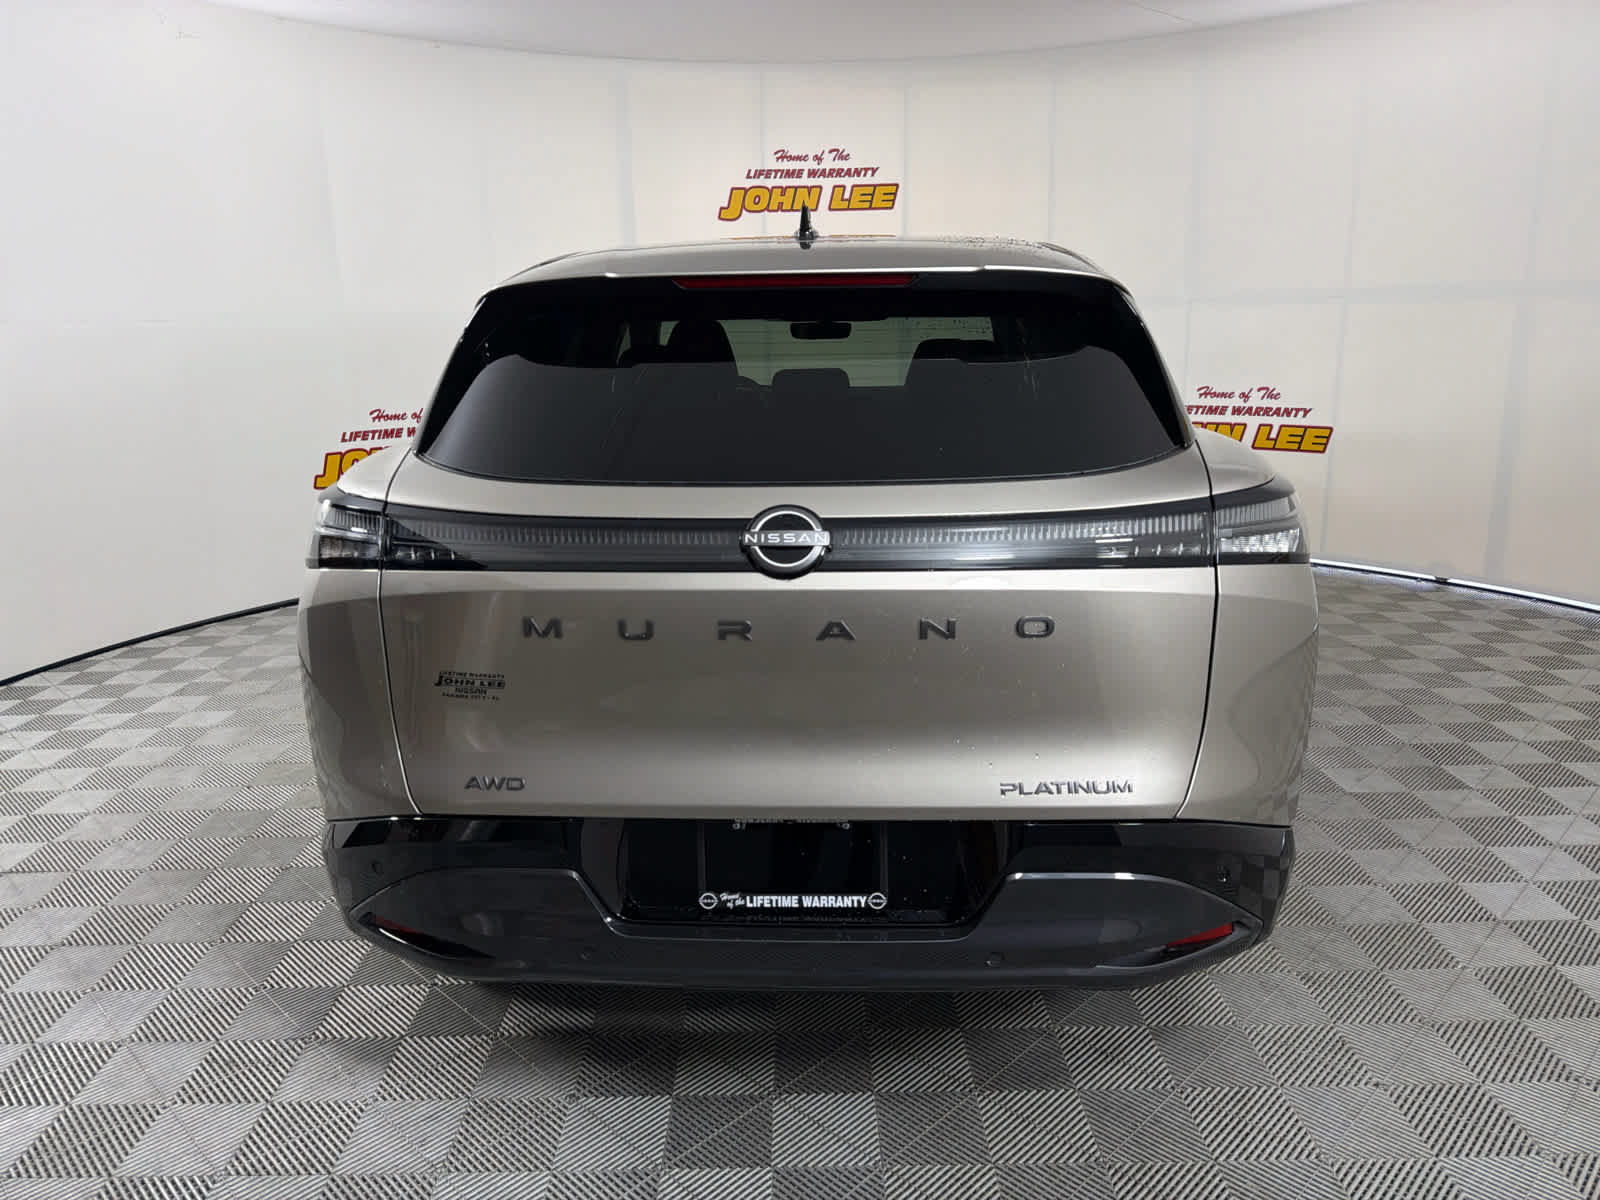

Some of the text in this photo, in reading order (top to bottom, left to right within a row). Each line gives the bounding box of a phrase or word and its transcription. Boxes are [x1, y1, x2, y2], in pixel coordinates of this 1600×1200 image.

[774, 148, 851, 165] Home of The
[745, 166, 880, 180] LIFETIME WARRANTY
[718, 183, 899, 221] JOHN LEE
[1196, 385, 1281, 403] Home of The
[369, 408, 424, 424] Home of
[1231, 405, 1313, 418] WARRANTY
[340, 427, 404, 443] LIFETIME
[1251, 423, 1333, 454] LEE
[744, 532, 828, 544] NISSAN
[521, 615, 1057, 641] MURANO
[434, 675, 506, 689] JOHN LEE
[464, 775, 526, 791] AWD
[1000, 779, 1134, 796] PLATINUM
[746, 895, 868, 908] LIFETIME WARRANTY
